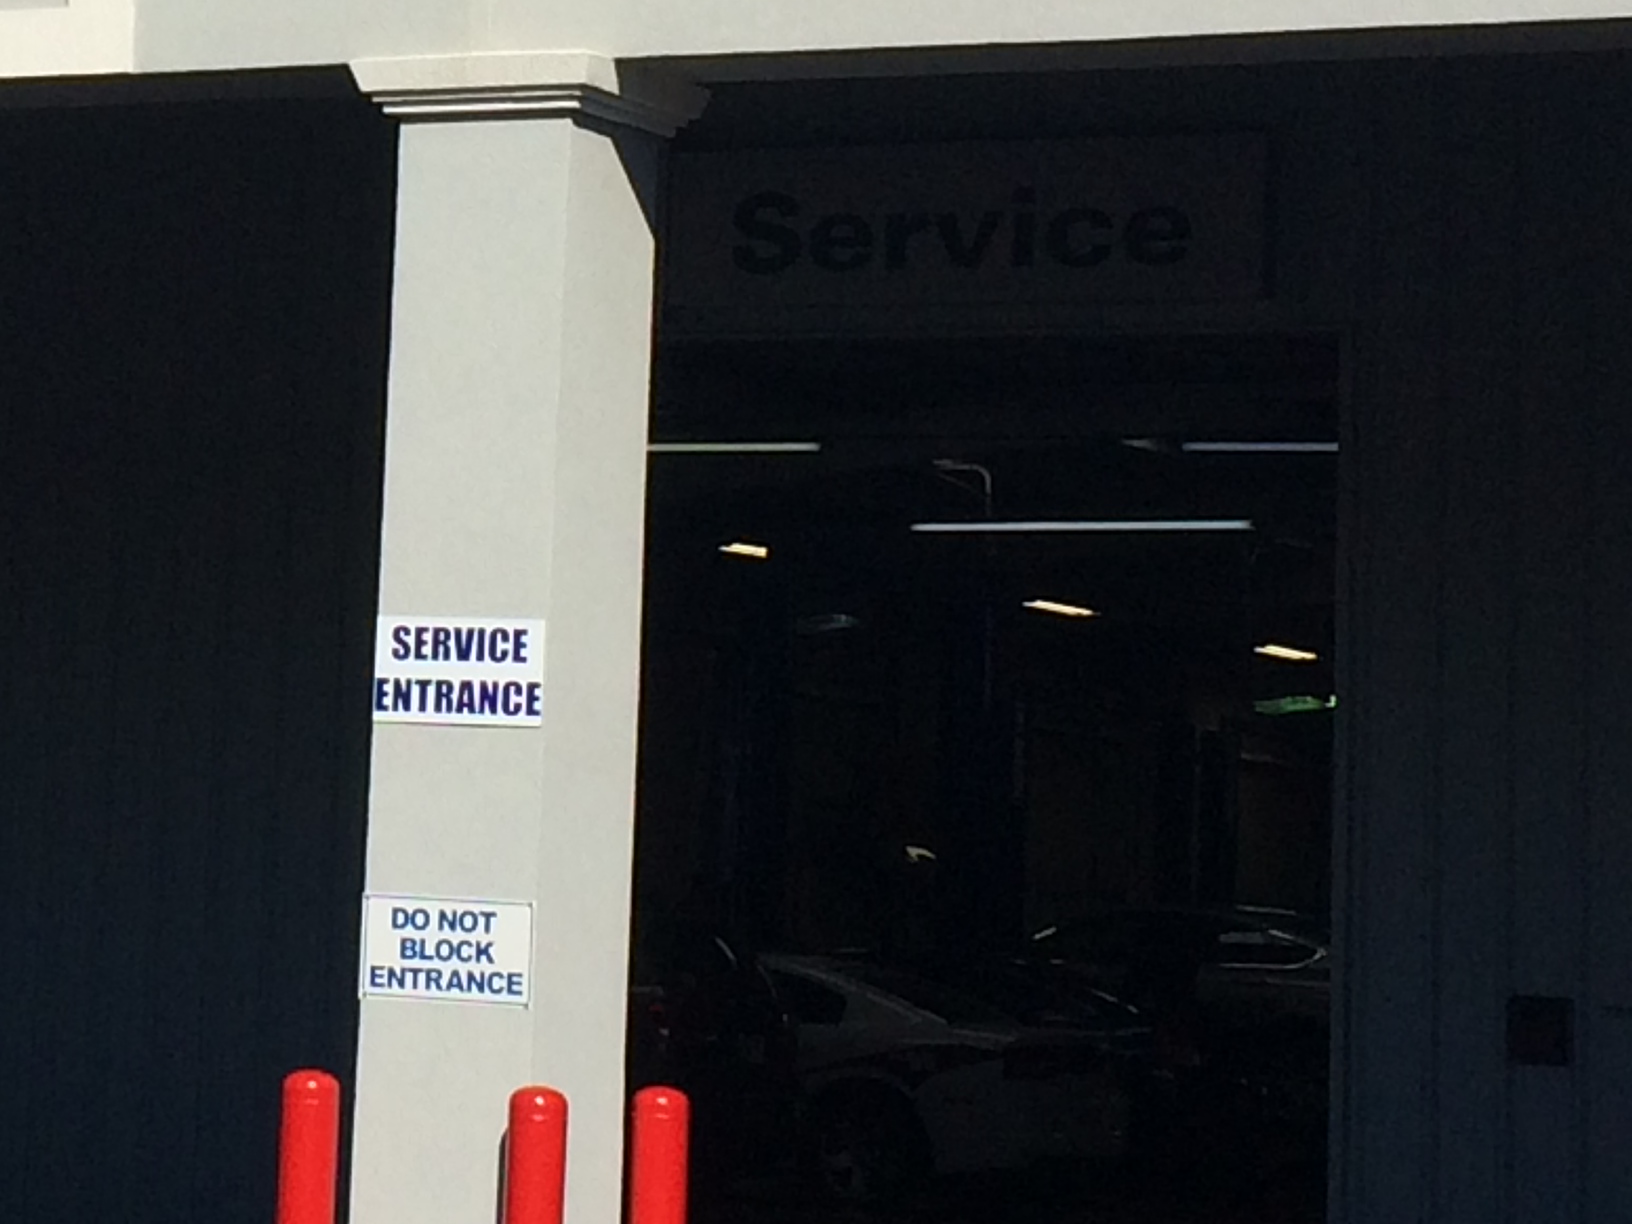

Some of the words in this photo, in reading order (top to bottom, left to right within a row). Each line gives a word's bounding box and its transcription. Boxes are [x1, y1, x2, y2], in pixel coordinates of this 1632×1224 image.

[731, 185, 1192, 276] Service
[390, 624, 529, 664] SERVICE
[374, 677, 543, 717] ENTRANCE
[390, 906, 431, 931] DO
[437, 908, 498, 935] NOT
[399, 937, 496, 965] BLOCK
[369, 964, 524, 997] ENTRANCE
